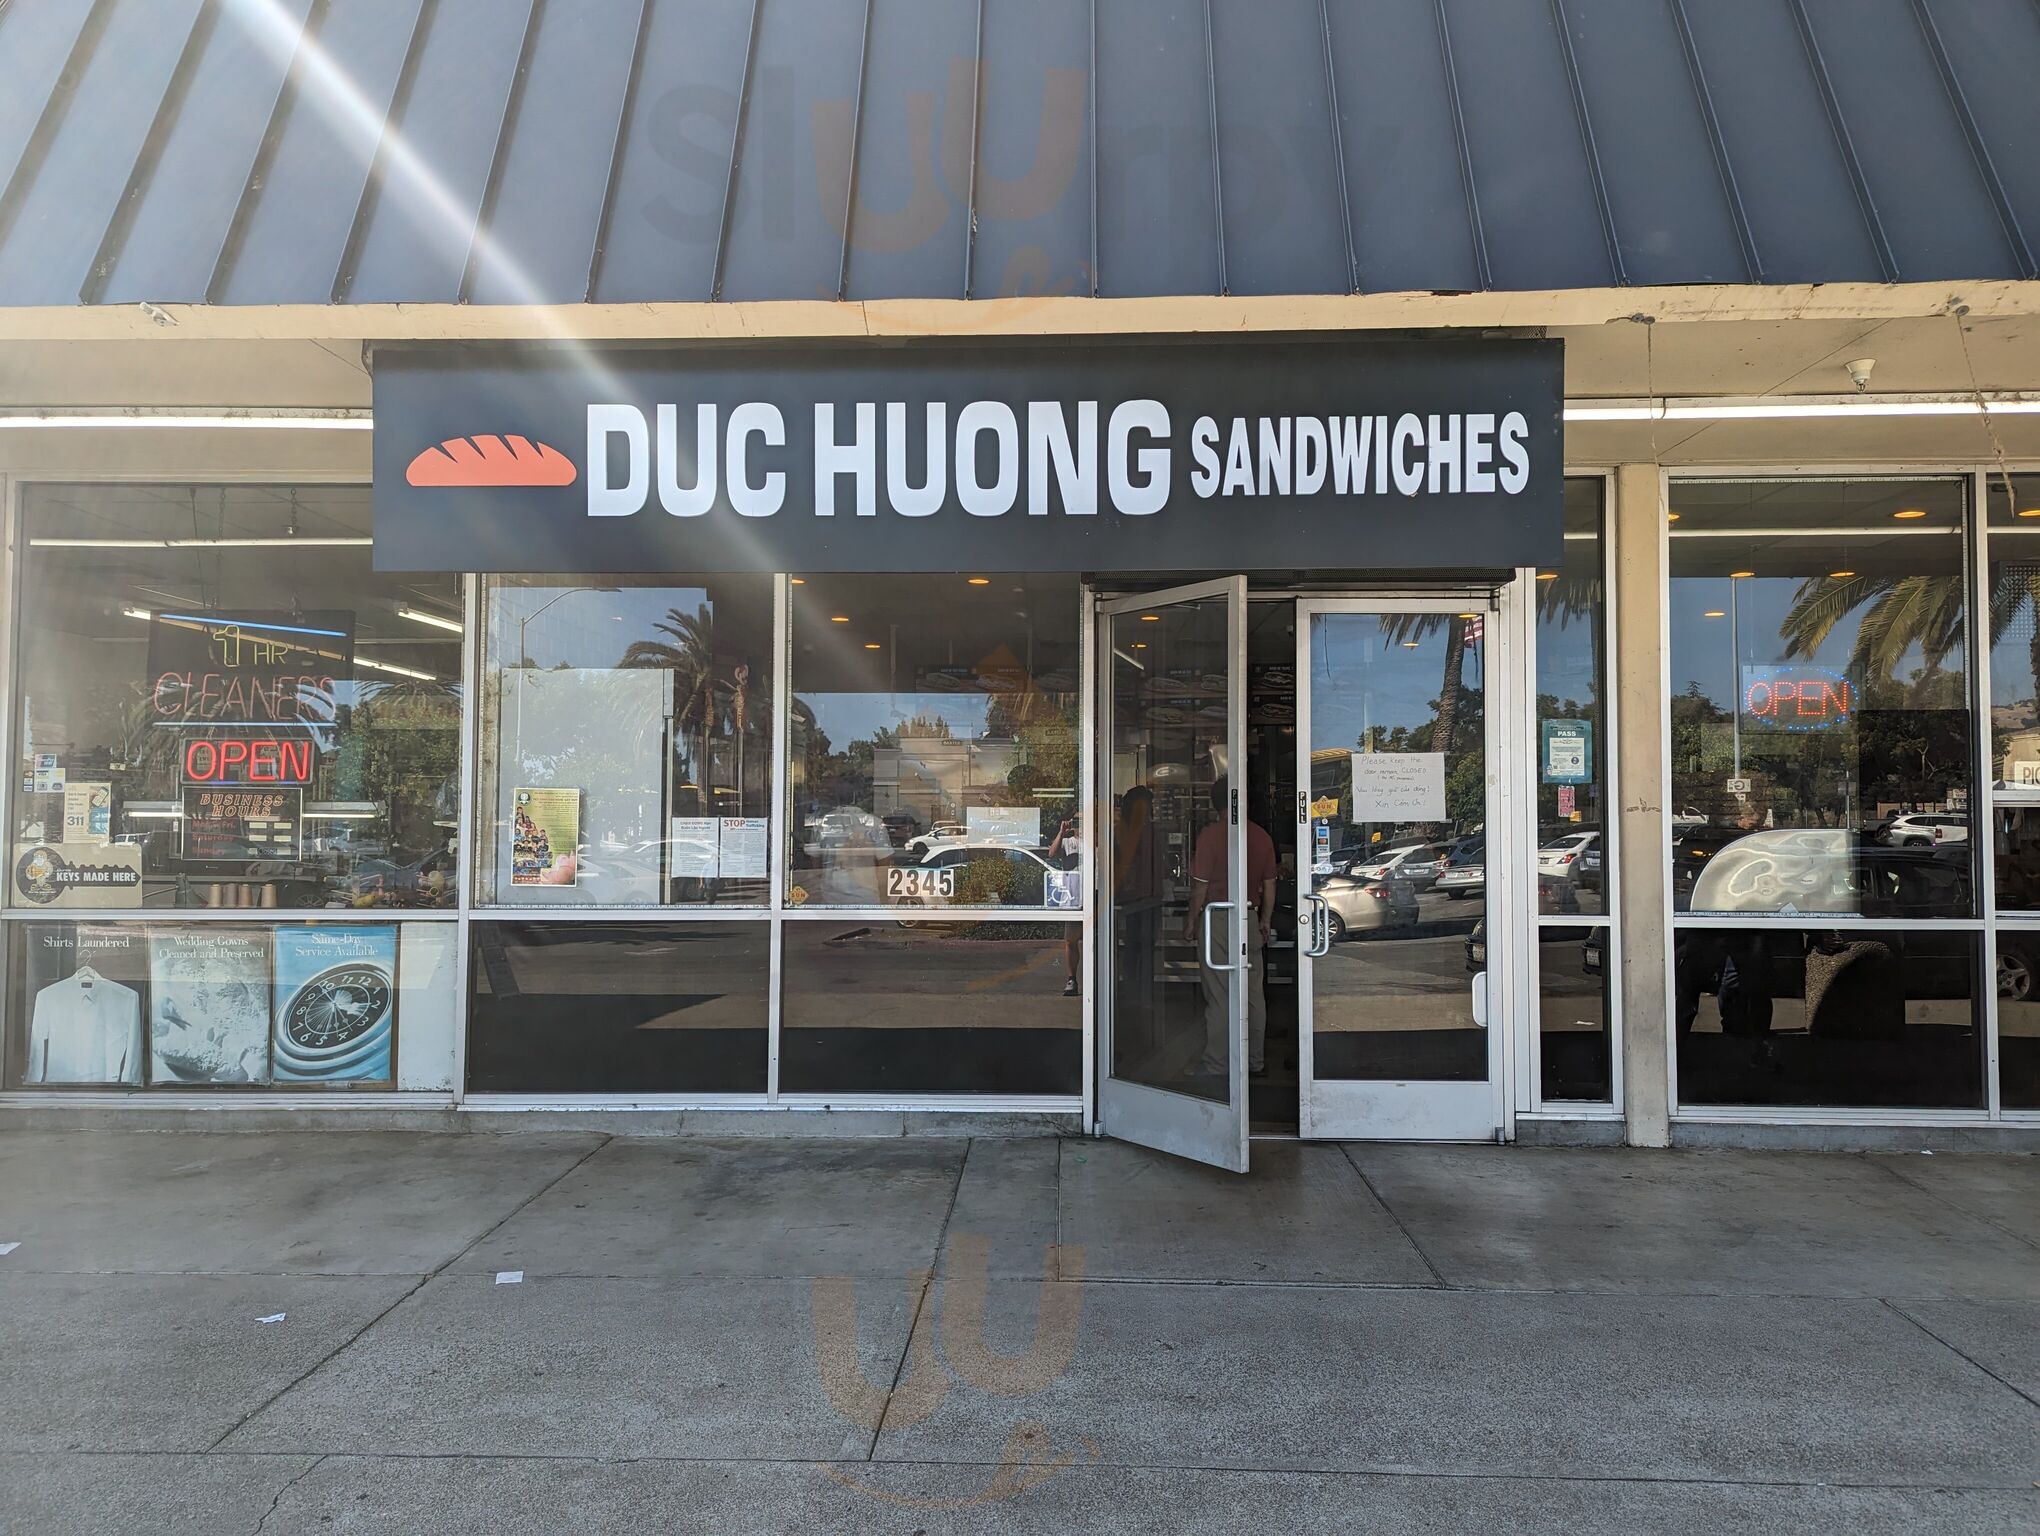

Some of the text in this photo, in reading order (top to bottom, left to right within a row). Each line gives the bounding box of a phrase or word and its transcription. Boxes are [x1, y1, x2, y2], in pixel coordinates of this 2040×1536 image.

[587, 399, 1529, 517] DUC HUONG SANDWICHES
[213, 625, 288, 667] 1 HR
[154, 671, 336, 722] CLEANERS
[1748, 681, 1850, 717] OPEN
[187, 741, 309, 781] OPEN
[1361, 756, 1386, 764] Please
[200, 793, 284, 806] BUSINESS
[1375, 799, 1389, 808] Xin
[211, 805, 272, 818] HOURS
[67, 816, 84, 826] 311
[723, 819, 746, 828] STOP
[56, 872, 136, 882] KEYS MADE HERE
[889, 869, 952, 895] 2345
[43, 935, 130, 948] Shirts Laundered
[174, 935, 249, 948] Wedding Gowns
[159, 948, 264, 959] Cleaned and Preserved
[295, 944, 378, 957] Service Available
[341, 975, 354, 984] 11
[358, 976, 372, 986] 12
[320, 980, 335, 990] 10
[305, 992, 316, 1002] 9
[371, 1000, 381, 1009] 2
[296, 1006, 307, 1015] 8
[292, 1022, 305, 1031] 7
[357, 1016, 369, 1027] 3
[300, 1032, 311, 1042] 6
[315, 1035, 328, 1045] 5
[338, 1031, 348, 1041] 4
